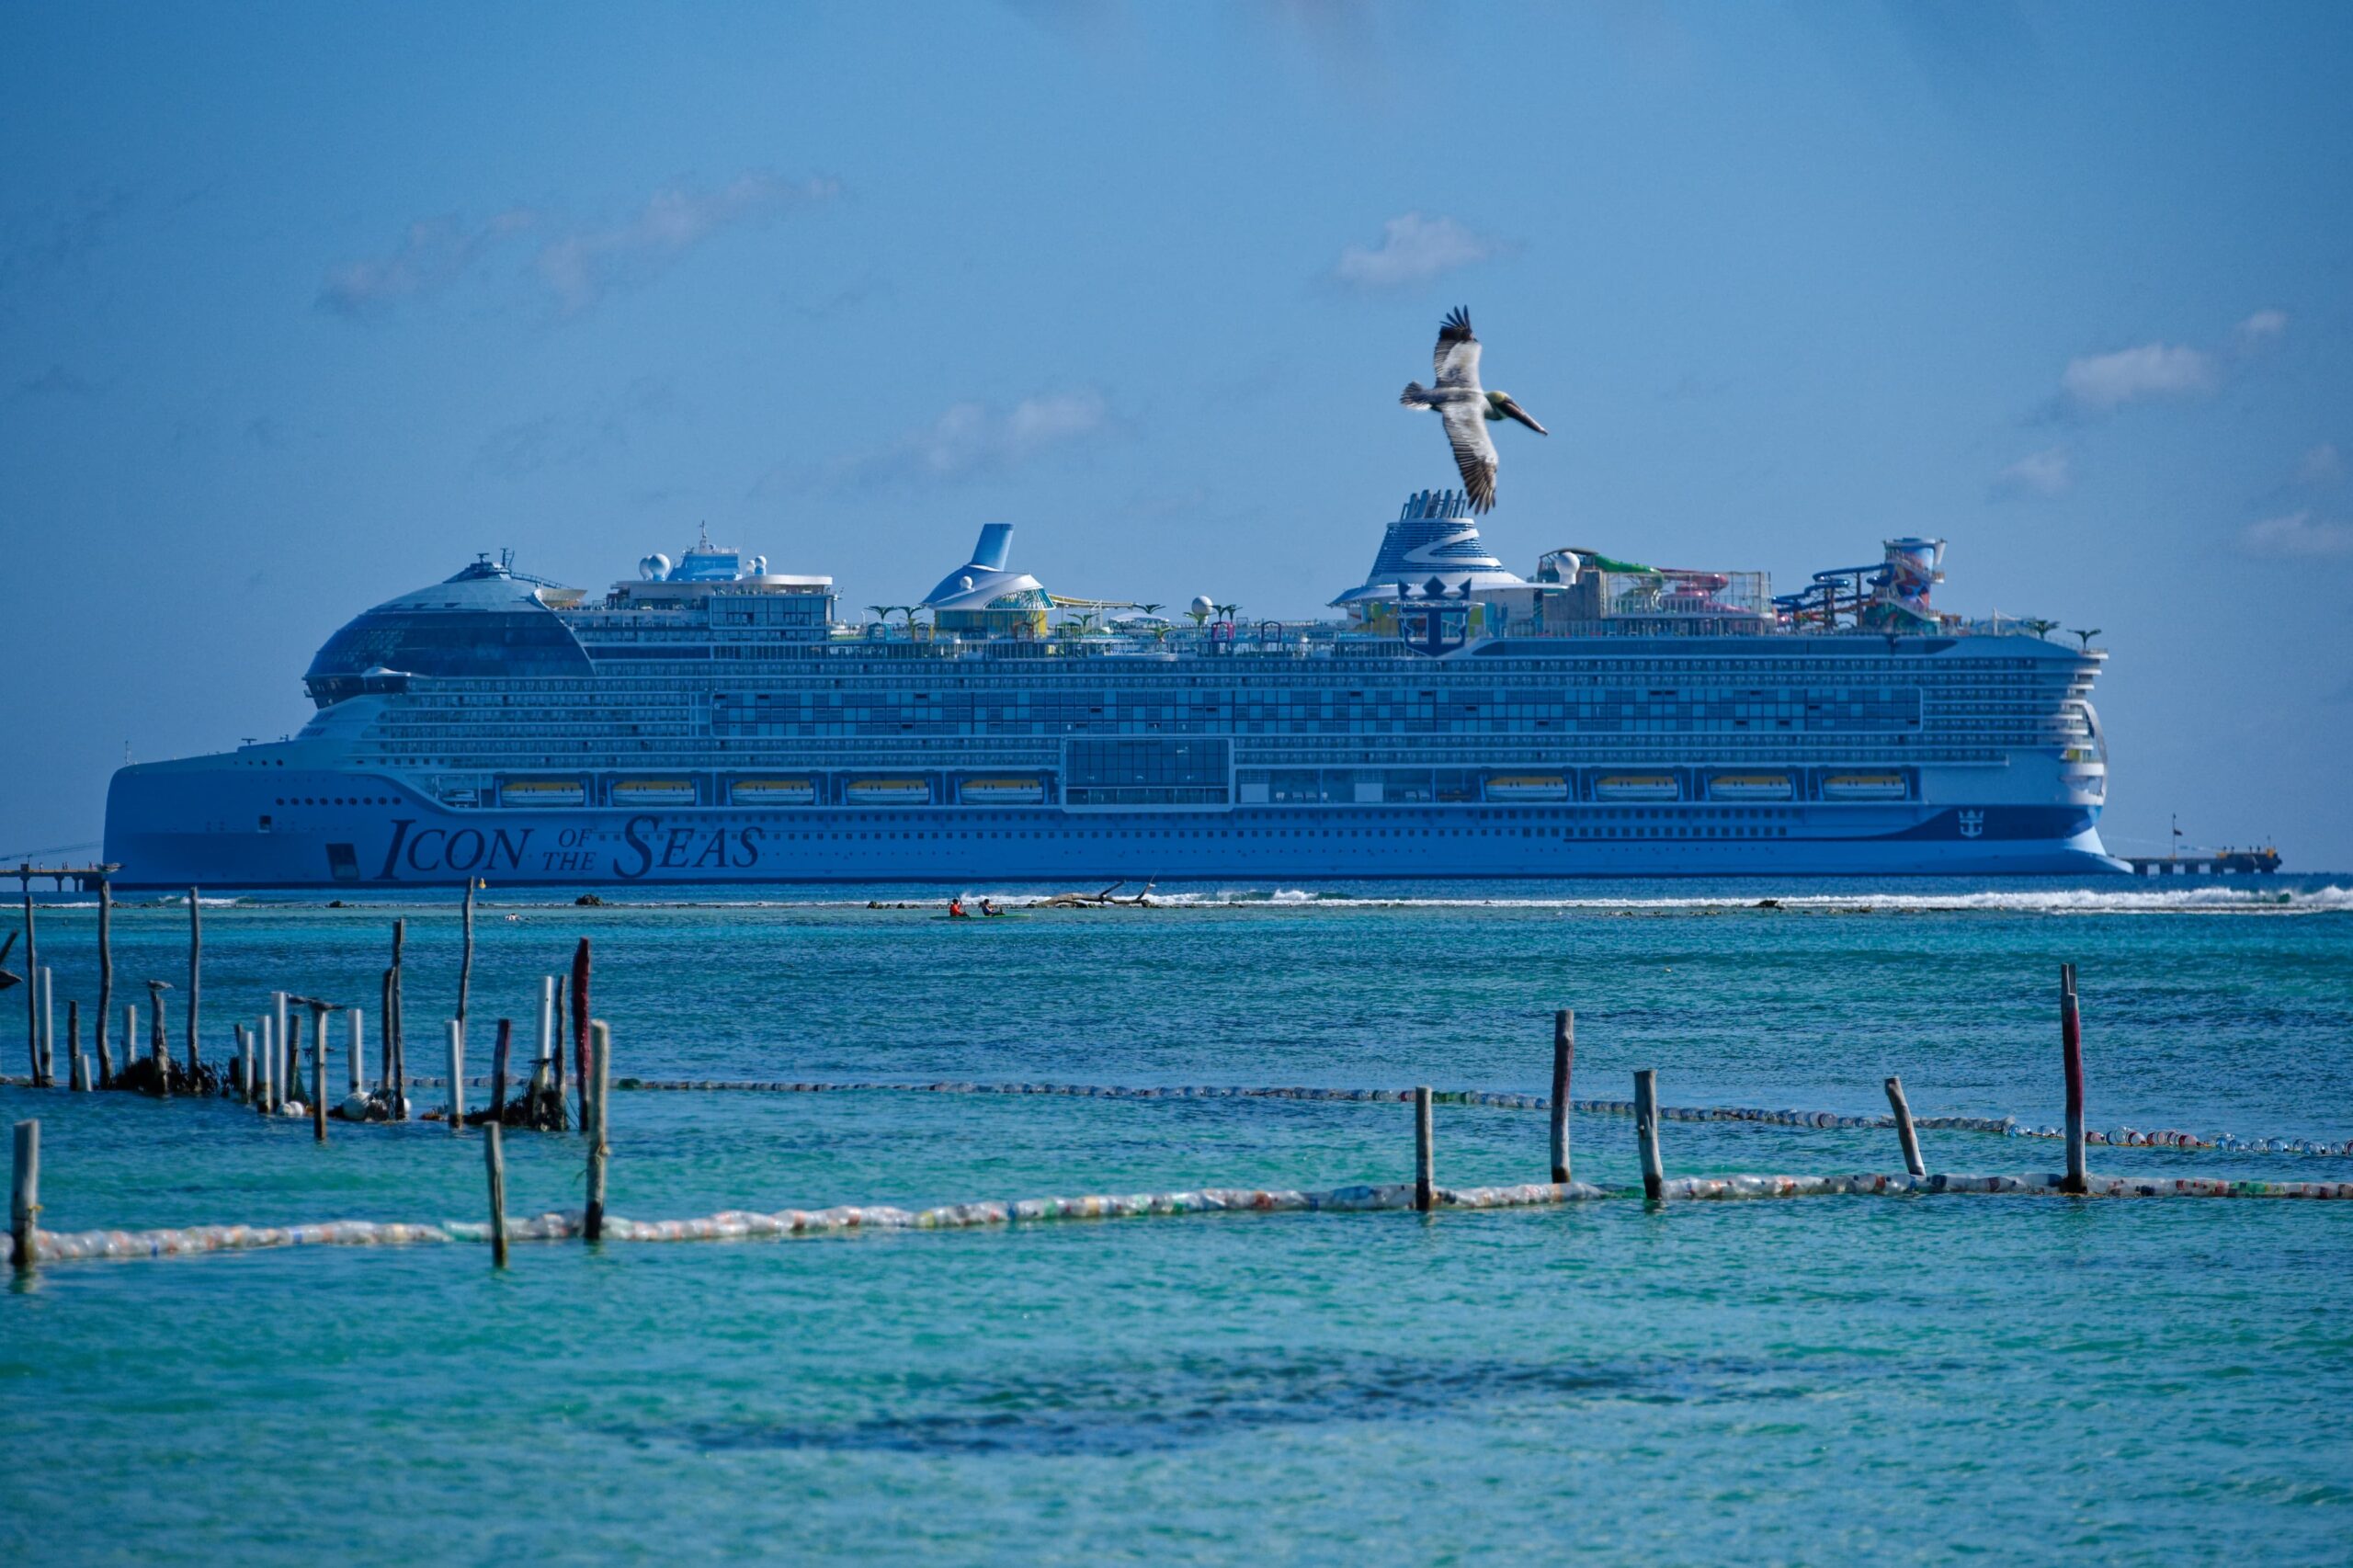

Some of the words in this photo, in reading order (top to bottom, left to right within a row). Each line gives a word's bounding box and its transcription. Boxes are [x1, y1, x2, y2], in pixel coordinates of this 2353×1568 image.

[372, 819, 535, 880] ICON
[558, 828, 593, 847] OF
[613, 814, 763, 879] SEAS
[542, 851, 596, 871] THE
